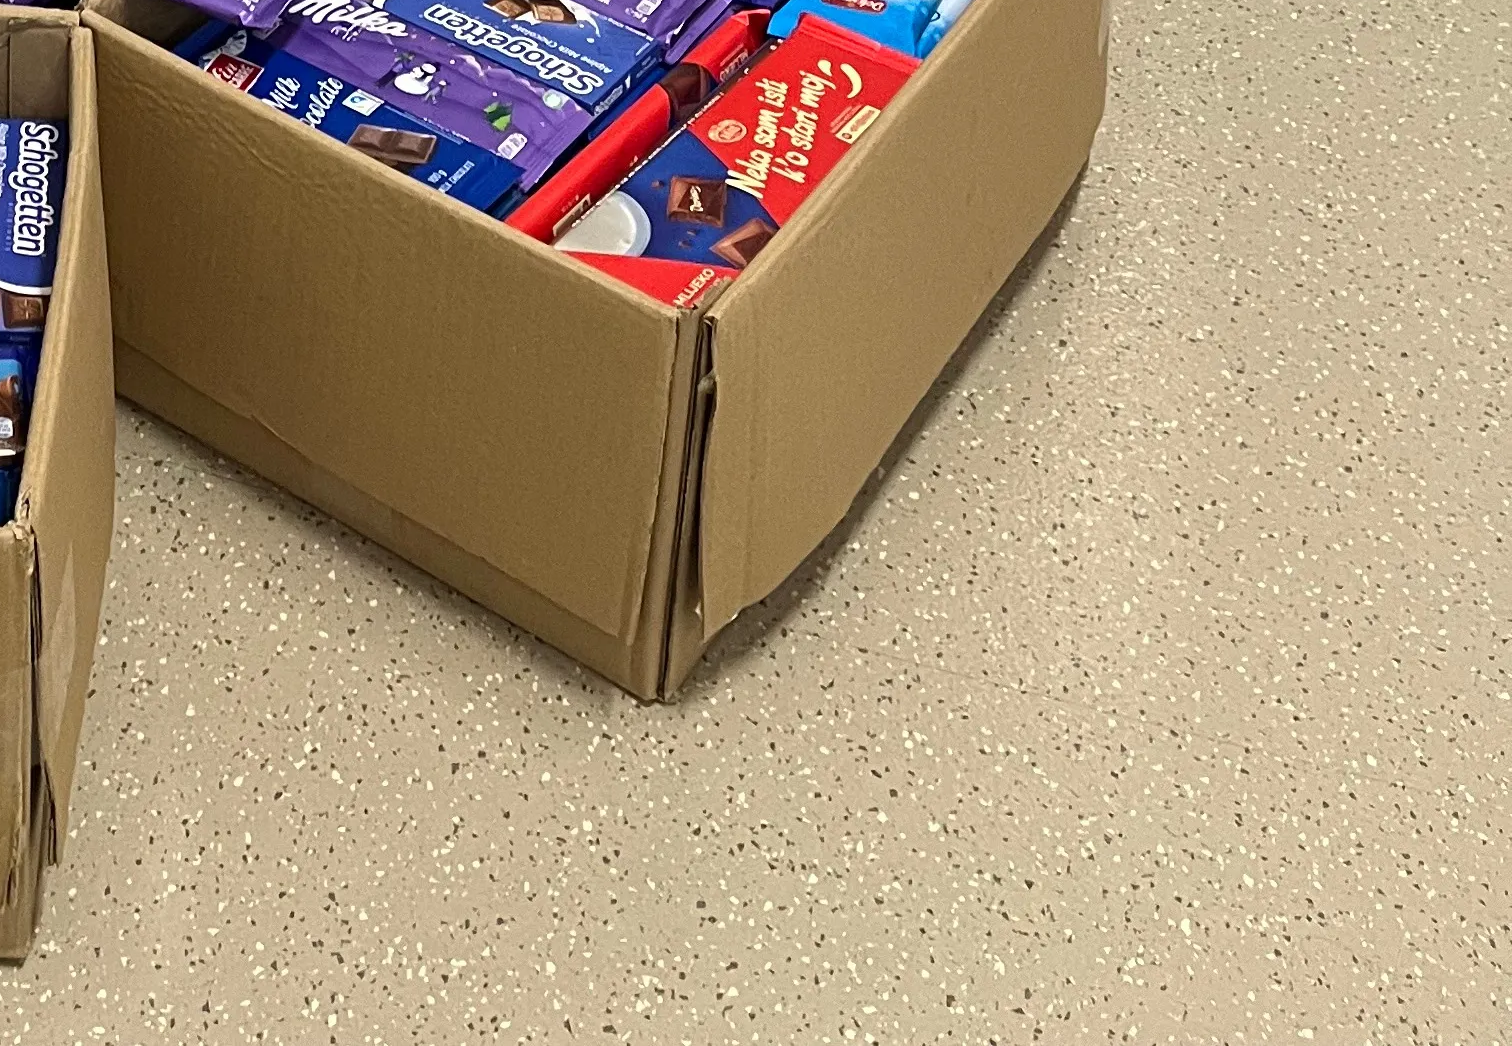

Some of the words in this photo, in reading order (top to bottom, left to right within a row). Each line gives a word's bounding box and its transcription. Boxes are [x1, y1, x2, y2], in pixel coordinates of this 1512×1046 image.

[423, 3, 604, 97] Schogetten
[300, 77, 344, 129] ocolate
[755, 77, 789, 108] isti
[753, 109, 784, 149] sam
[780, 106, 819, 151] stari
[8, 121, 59, 257] Schogetten
[725, 148, 774, 199] Neka
